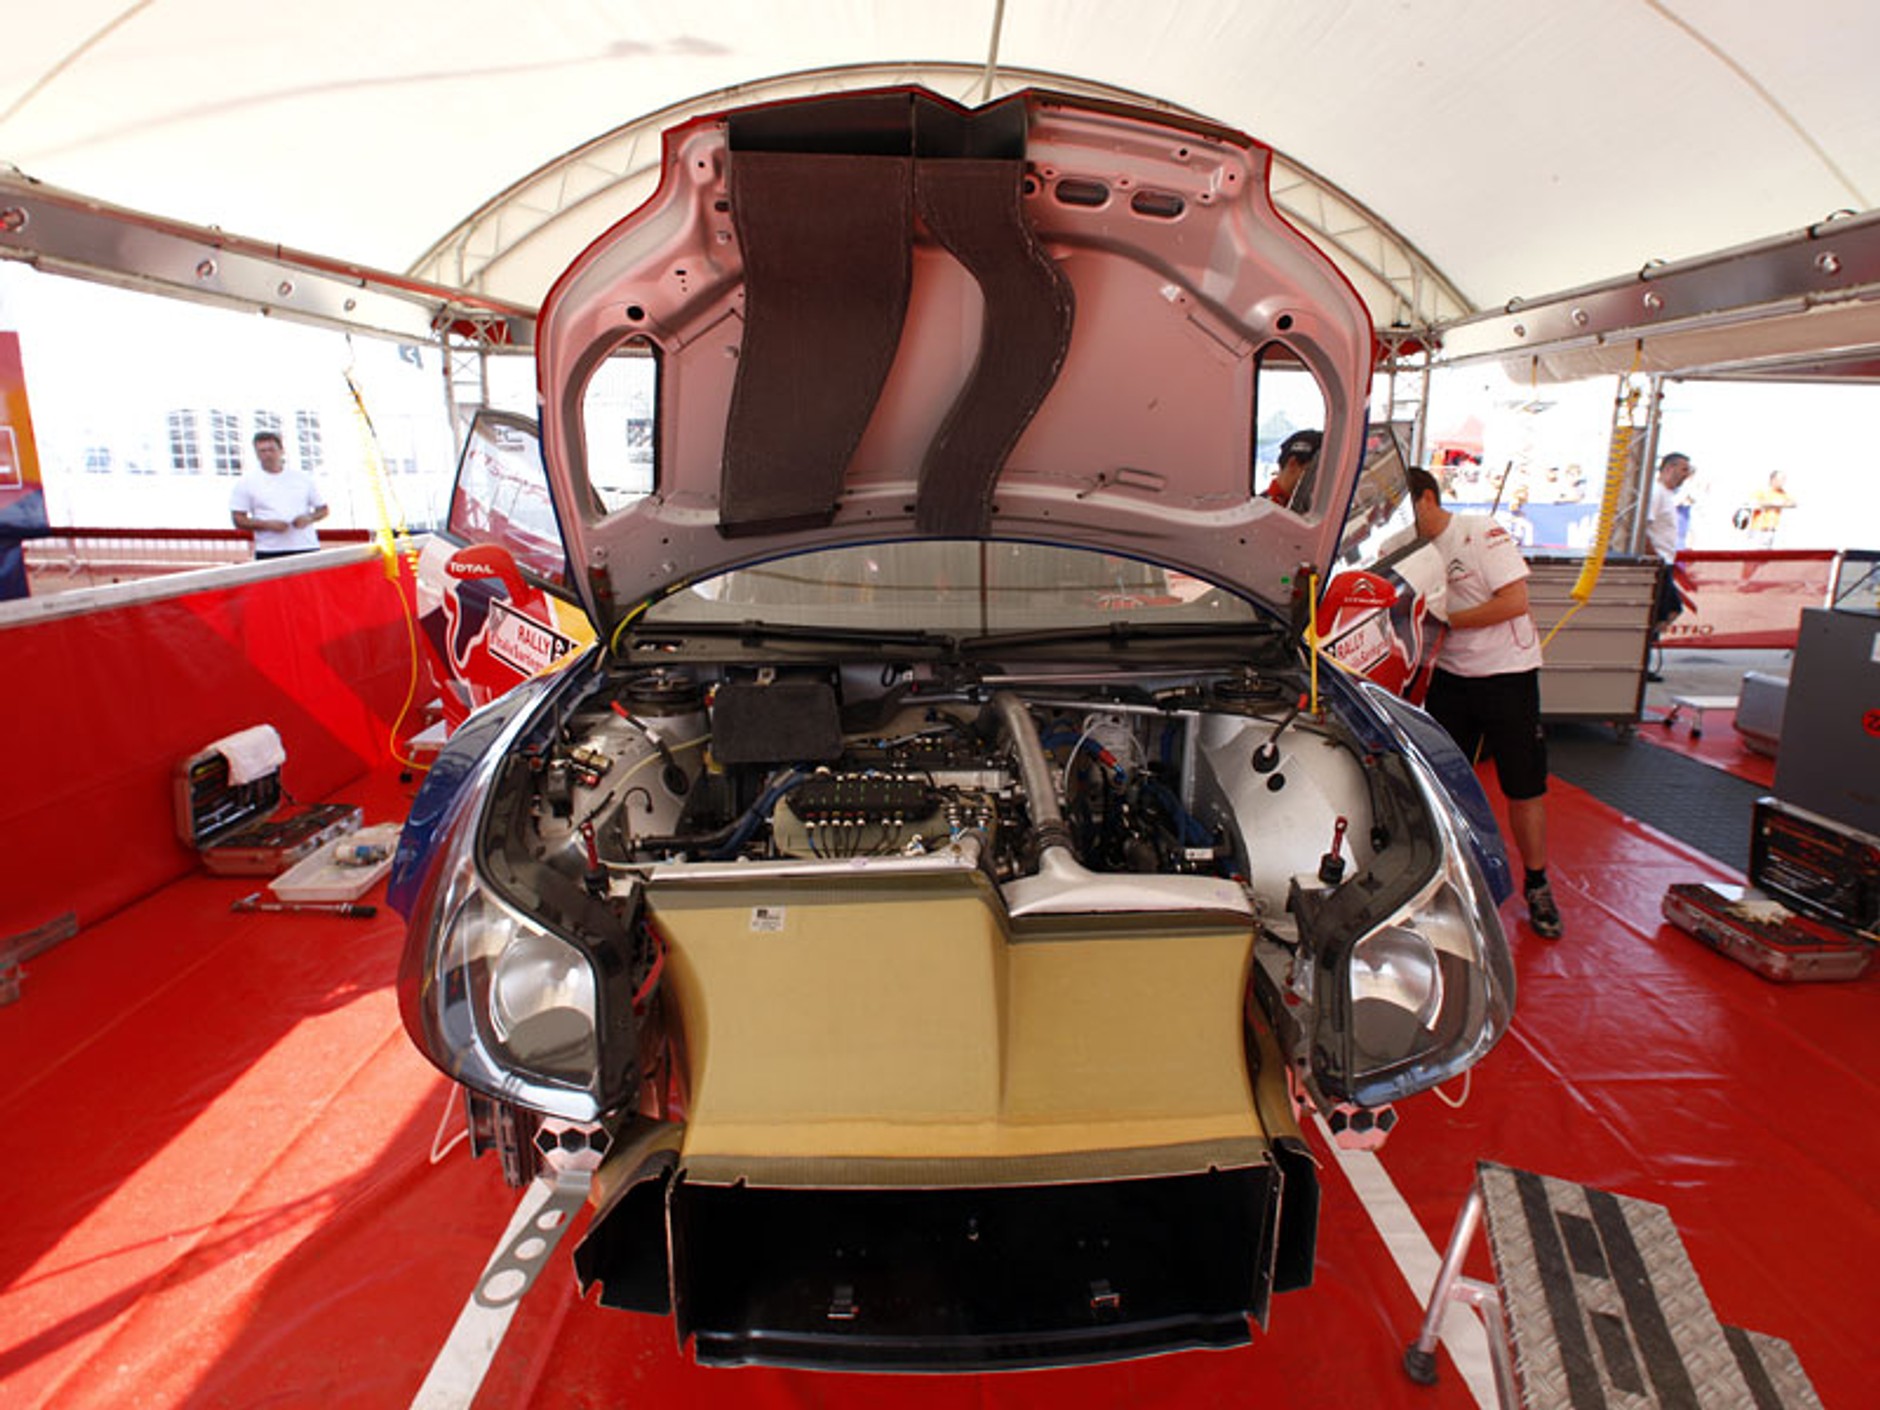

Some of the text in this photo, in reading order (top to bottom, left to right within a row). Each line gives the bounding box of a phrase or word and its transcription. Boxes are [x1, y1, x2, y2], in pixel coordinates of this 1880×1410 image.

[451, 562, 494, 574] TOTAL
[518, 625, 550, 656] RALLY
[1337, 630, 1365, 660] RALLY
